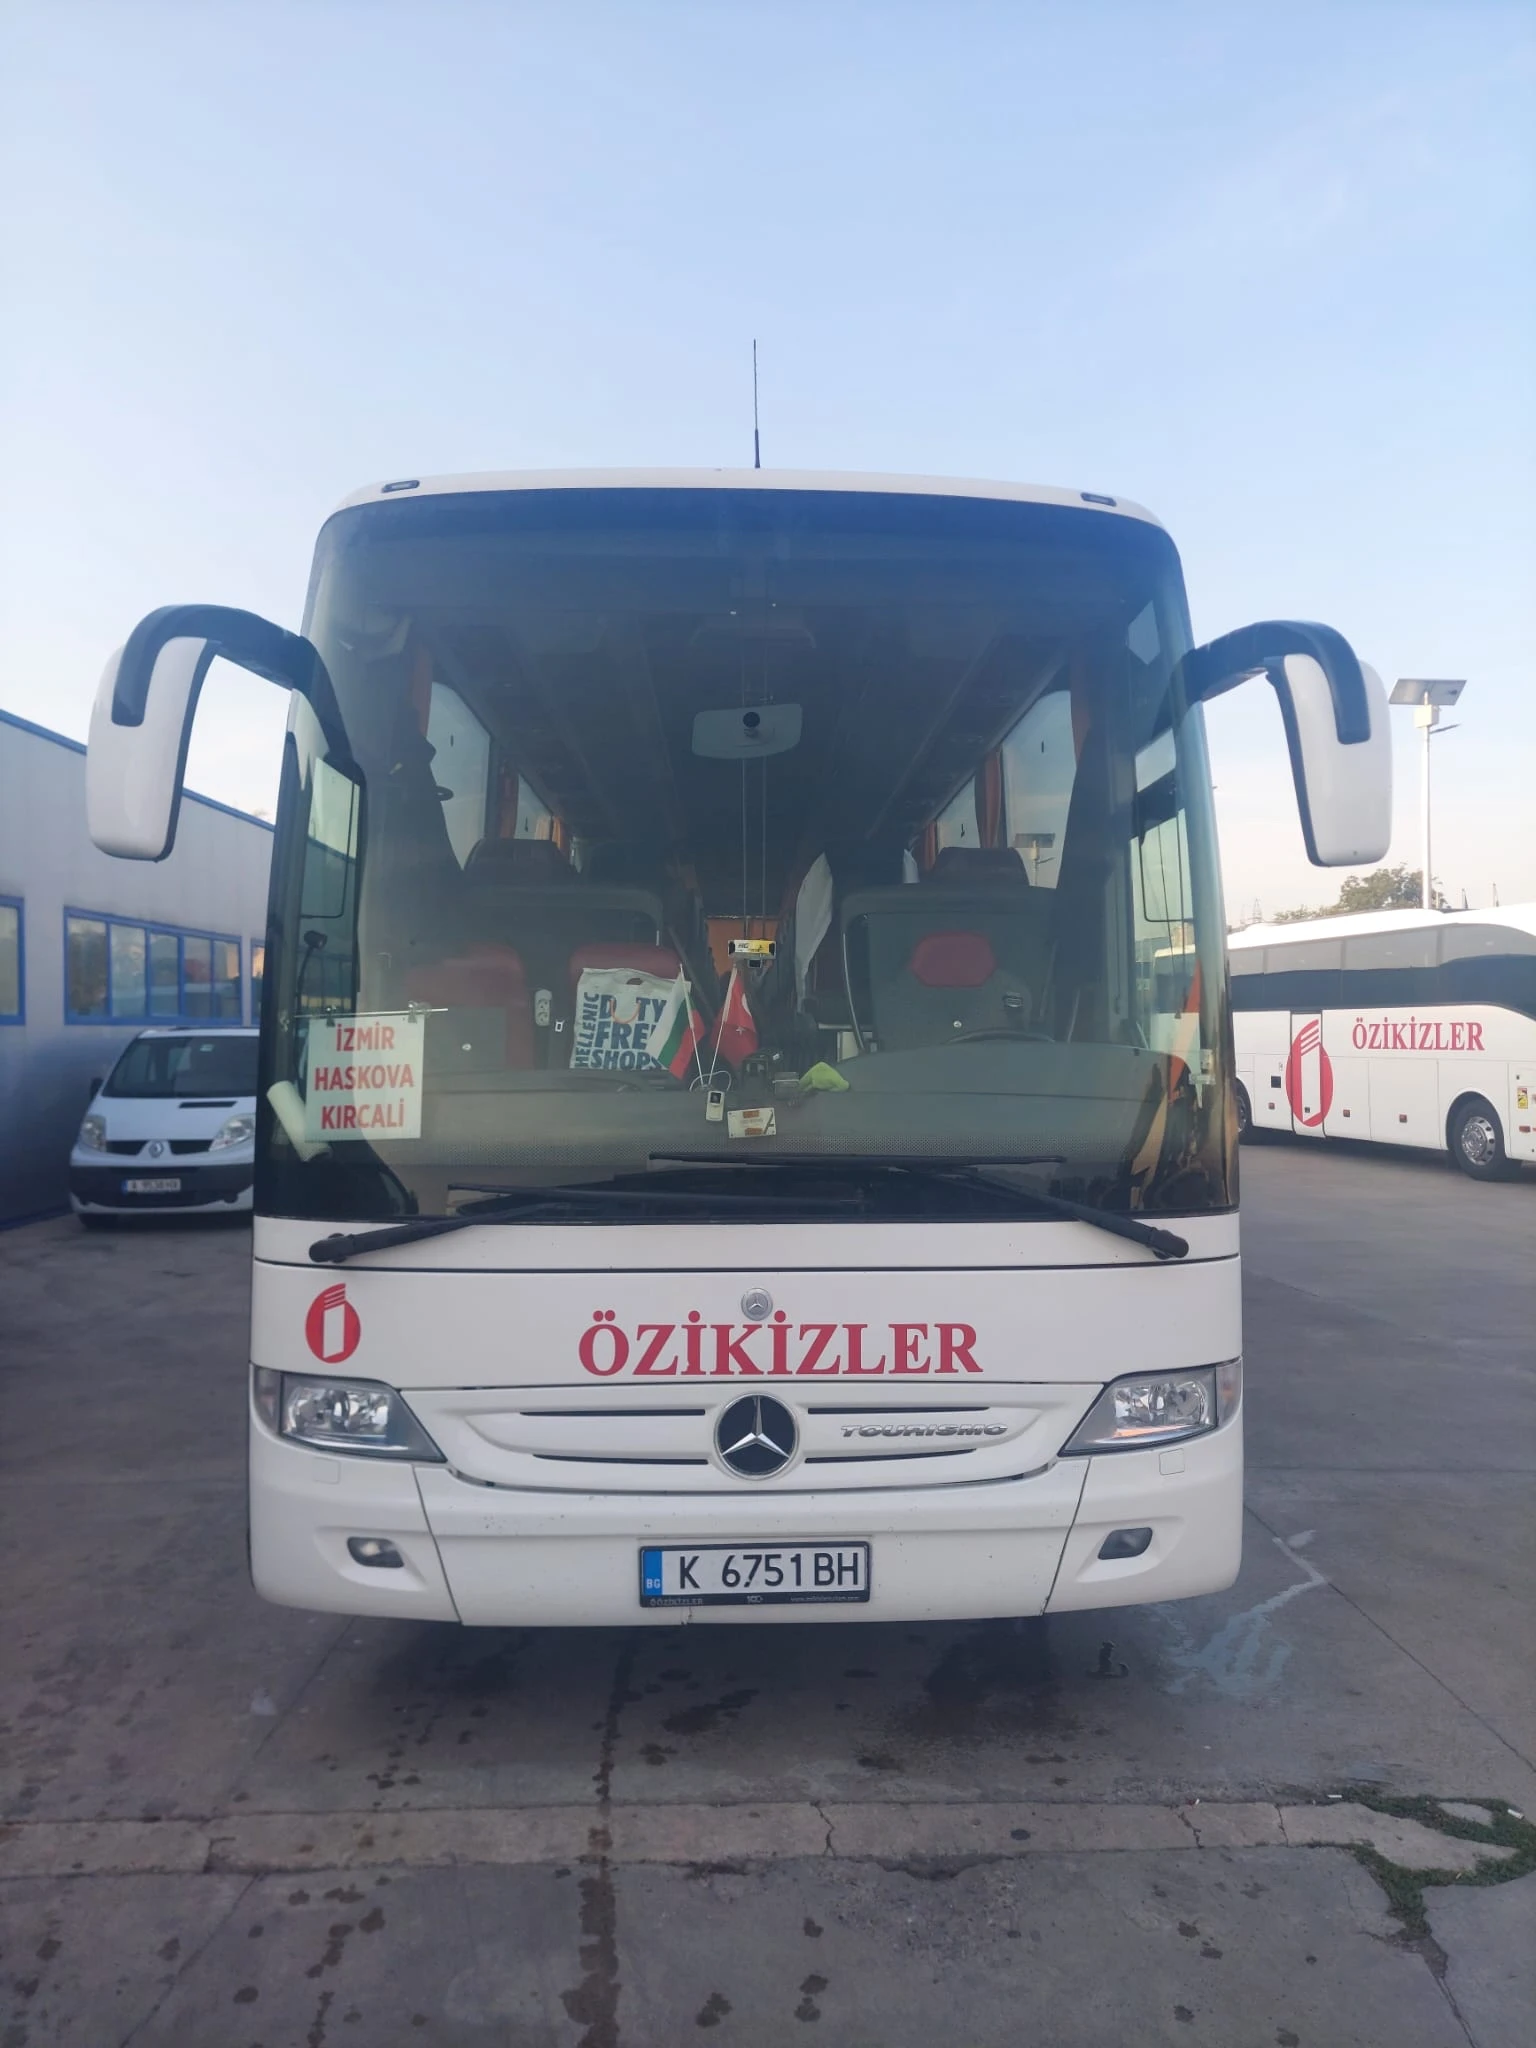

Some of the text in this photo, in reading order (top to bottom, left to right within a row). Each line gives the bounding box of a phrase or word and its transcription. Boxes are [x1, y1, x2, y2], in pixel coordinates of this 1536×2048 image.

[336, 1022, 395, 1052] İZMİR
[575, 992, 600, 1068] HELLENIC
[594, 1020, 657, 1050] FRE
[1352, 1016, 1485, 1051] ÖZİKİZLER
[314, 1064, 414, 1091] HASKOVA
[321, 1099, 404, 1129] KIRCALİ
[578, 1310, 984, 1377] ÖZİKİZLER
[841, 1424, 1008, 1437] TOURISMO
[646, 1579, 661, 1589] BG
